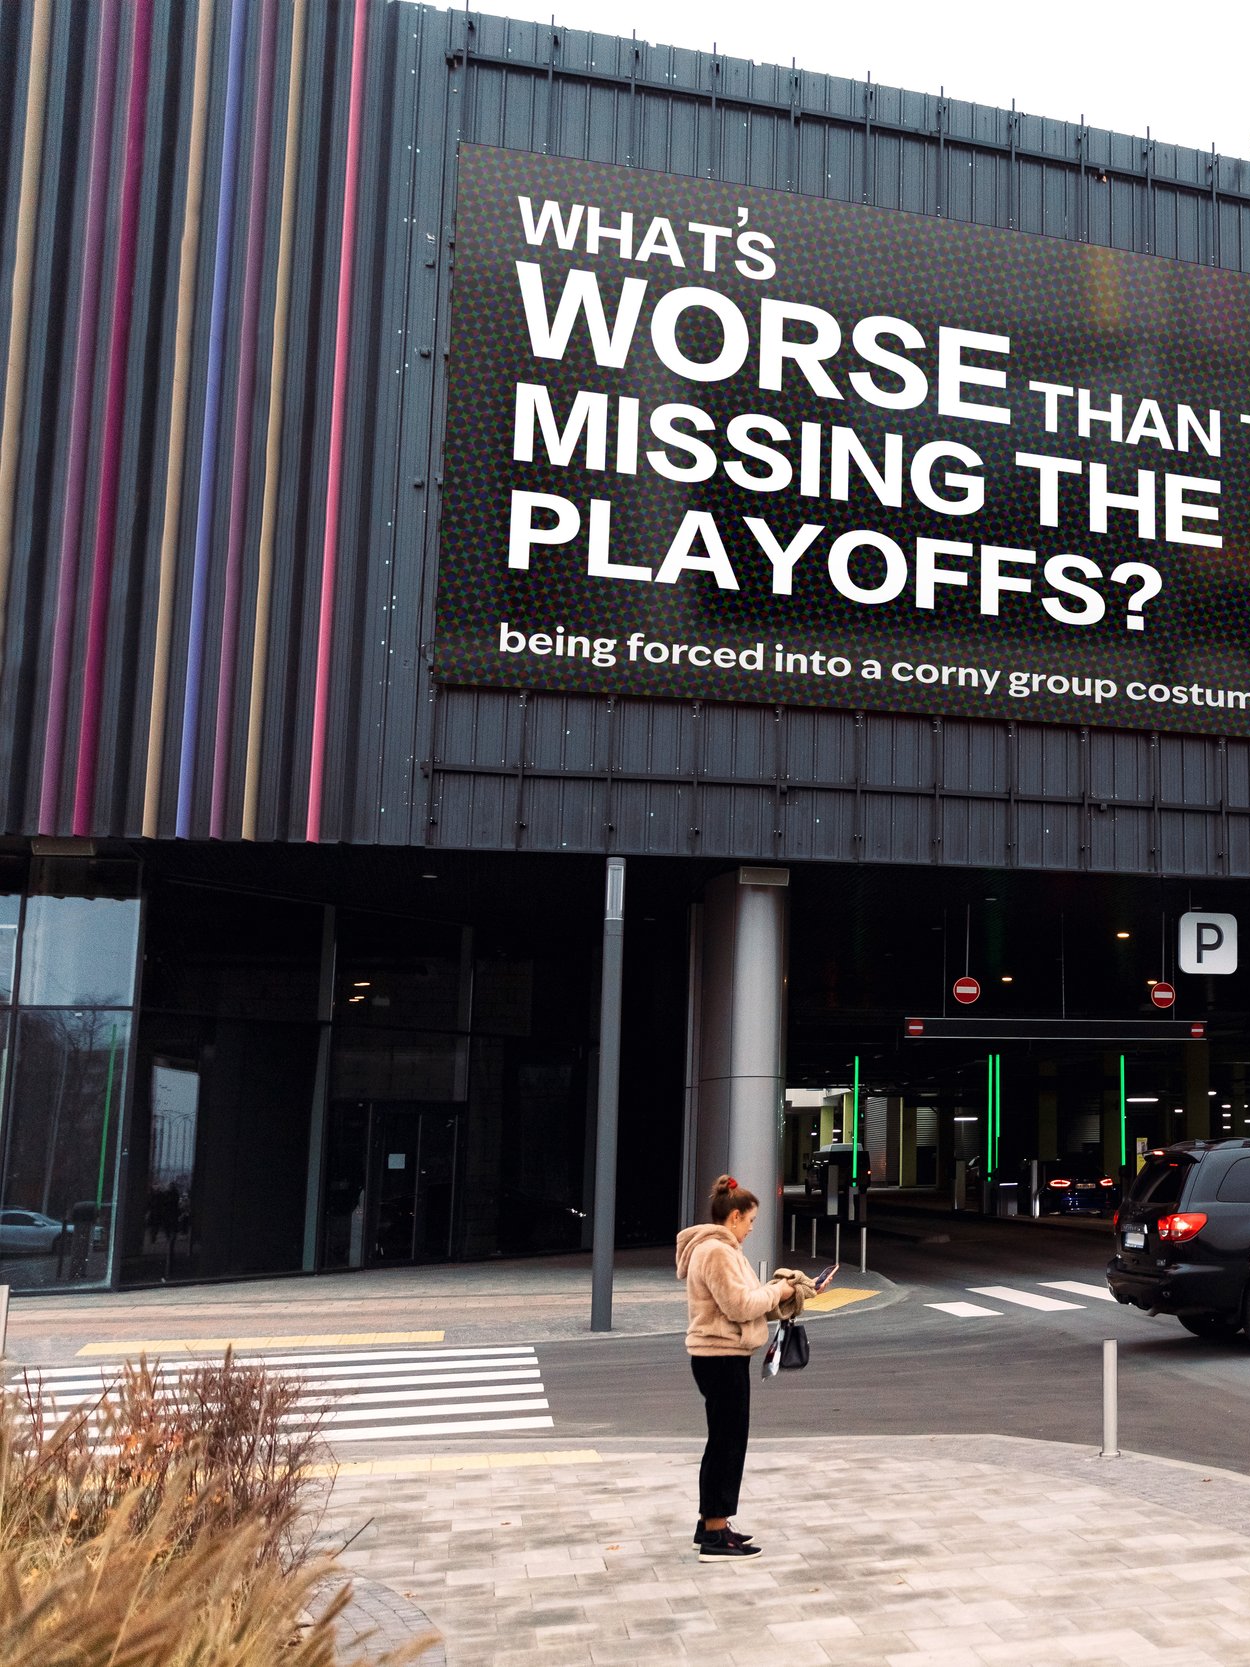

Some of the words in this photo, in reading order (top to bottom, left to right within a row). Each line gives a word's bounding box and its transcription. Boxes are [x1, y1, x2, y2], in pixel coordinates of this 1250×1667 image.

[517, 195, 777, 281] WHAT'S
[515, 260, 1011, 425] WORSE
[1028, 380, 1221, 458] THAN
[513, 382, 985, 516] MISSING
[1015, 451, 1223, 549] THE
[508, 489, 1163, 631] PLAYOFFS?
[499, 622, 618, 667] being
[626, 632, 764, 671] forced
[775, 643, 852, 677] into
[861, 659, 882, 680] a
[891, 662, 1001, 695] corny
[1008, 671, 1118, 704] group
[1196, 922, 1224, 964] P
